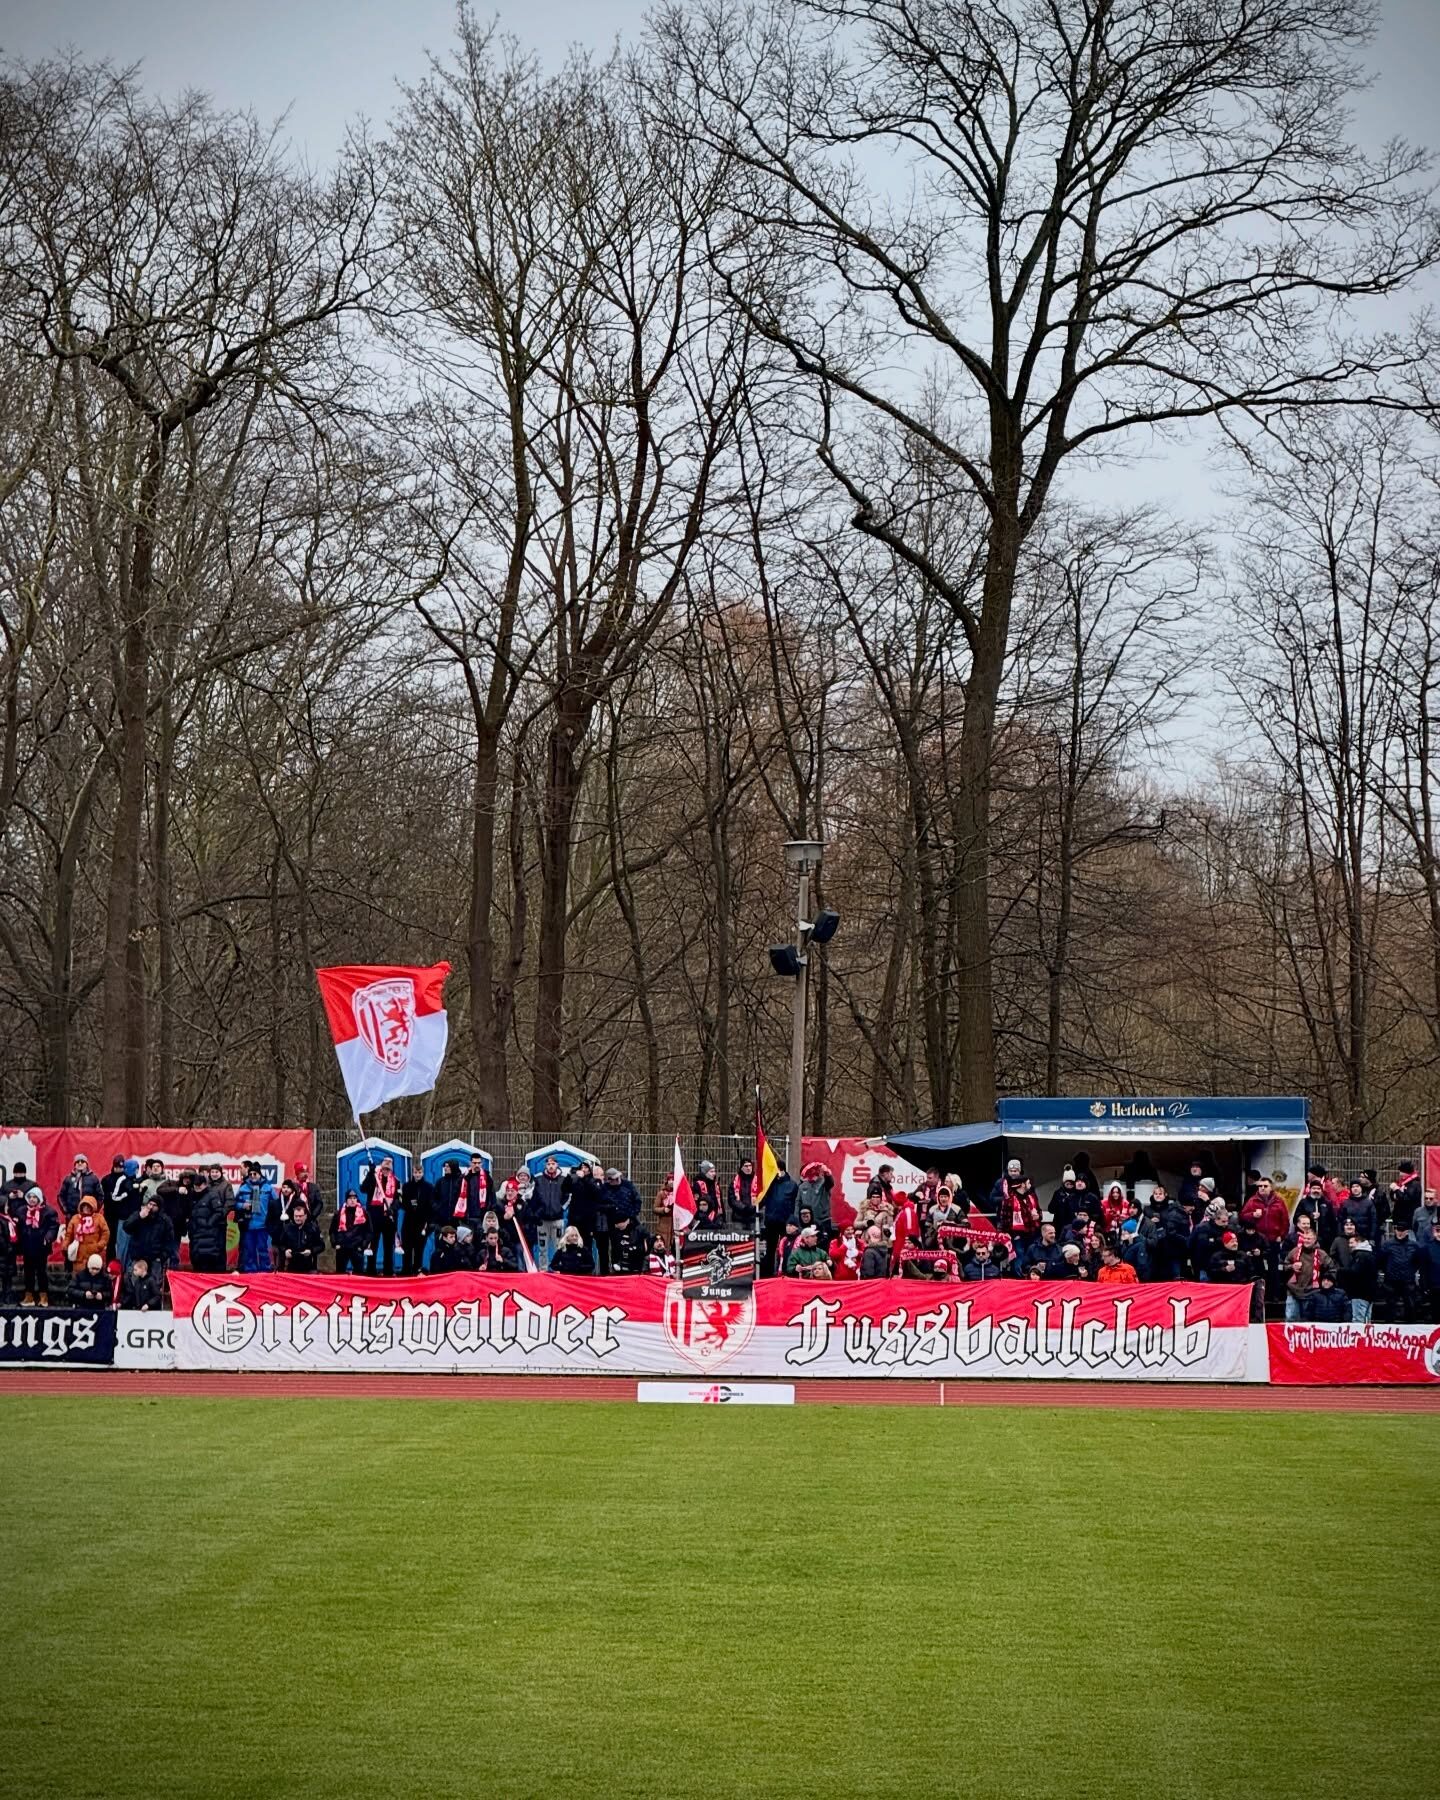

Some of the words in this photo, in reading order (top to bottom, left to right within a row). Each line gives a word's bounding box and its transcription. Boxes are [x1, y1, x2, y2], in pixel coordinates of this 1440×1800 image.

[1111, 1102, 1165, 1117] Herforder
[687, 1231, 750, 1243] Greifswalder
[701, 1285, 733, 1297] Jungs
[785, 1295, 1212, 1369] Fussballclub
